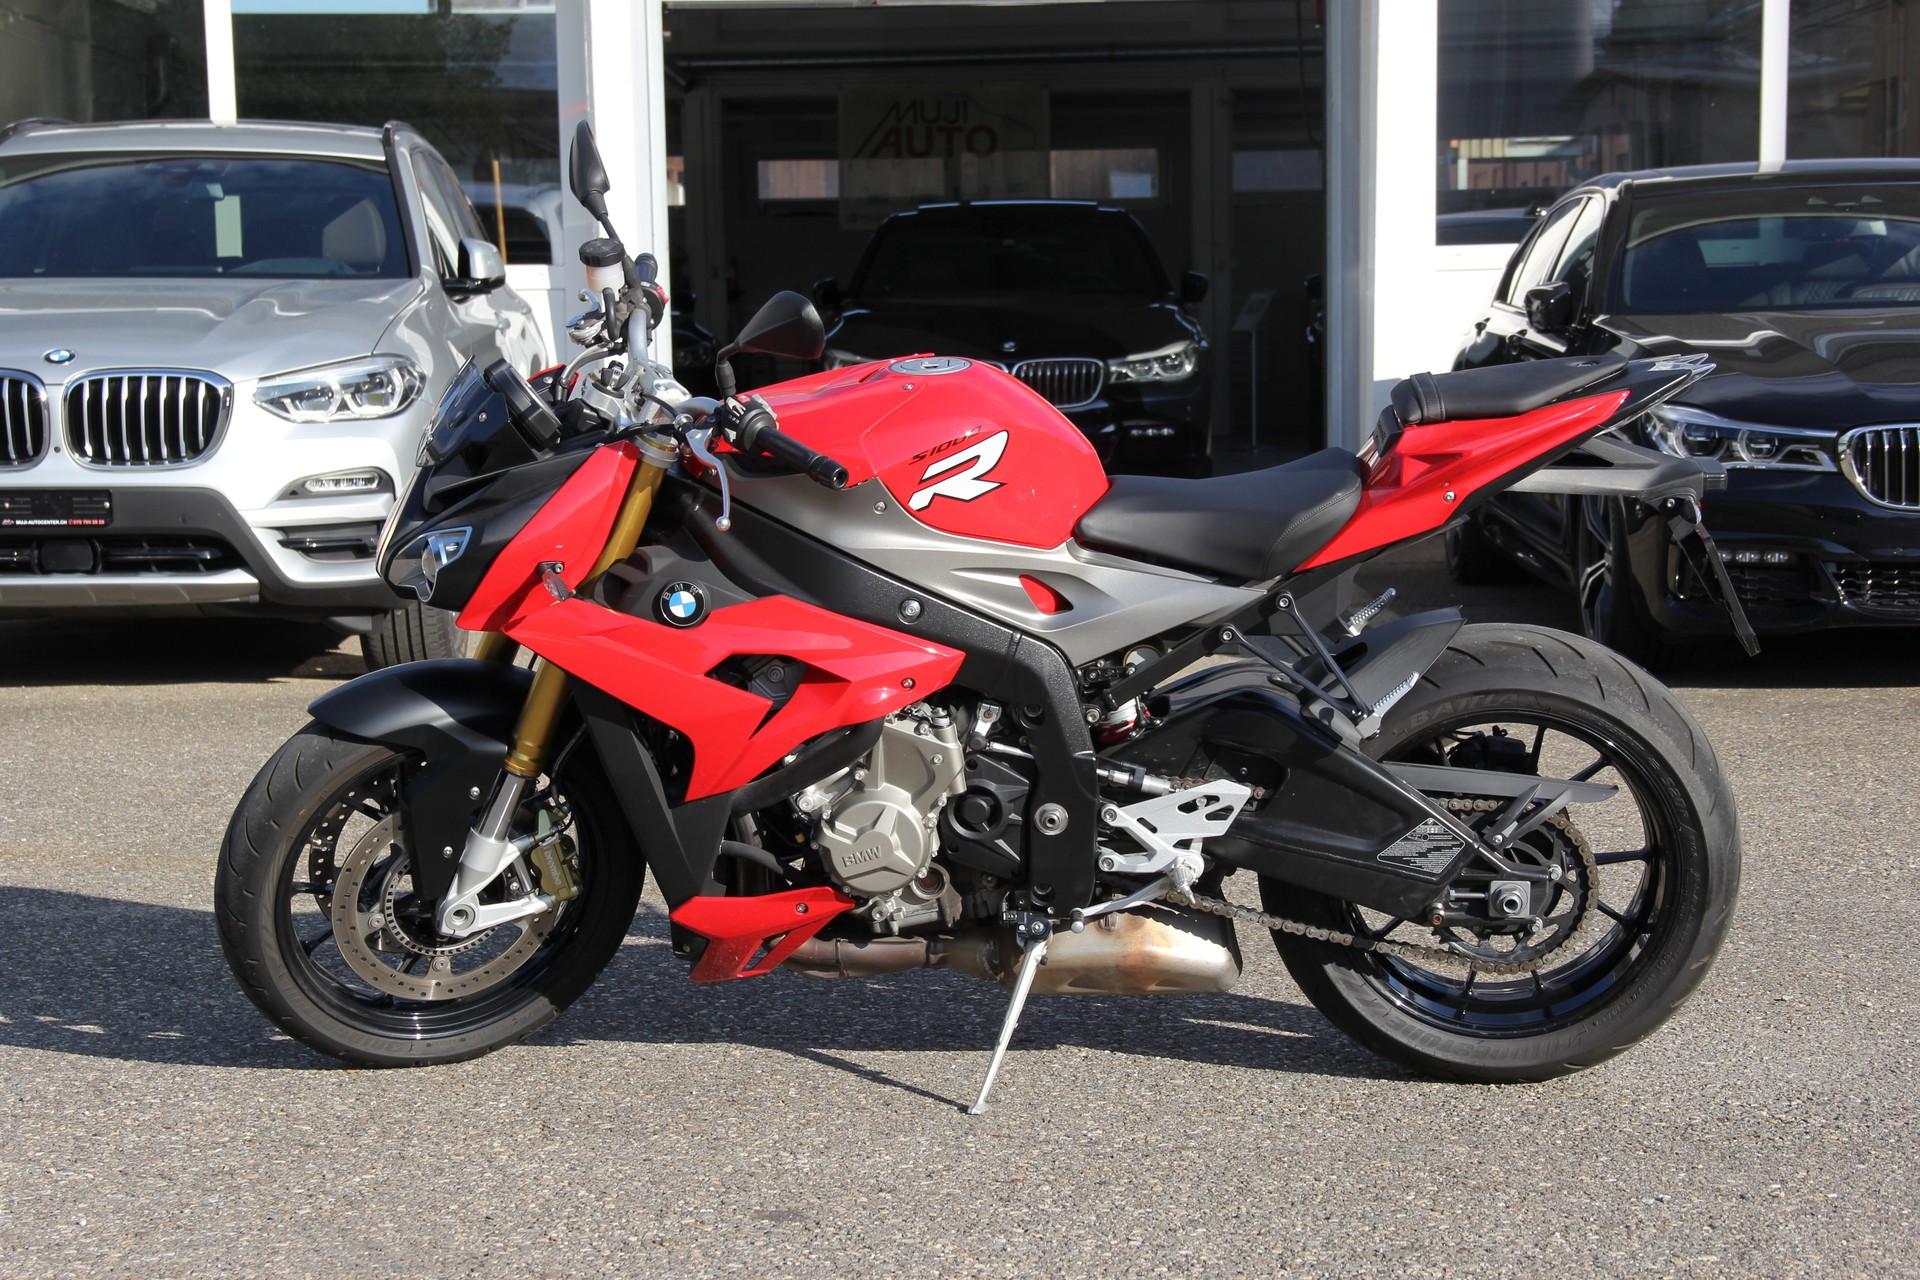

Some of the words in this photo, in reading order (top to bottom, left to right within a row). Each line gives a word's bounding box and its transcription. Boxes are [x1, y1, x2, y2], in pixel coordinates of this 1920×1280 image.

[869, 125, 998, 158] AUTO
[908, 430, 1010, 512] R
[663, 583, 699, 600] BMW
[842, 845, 881, 868] BMW
